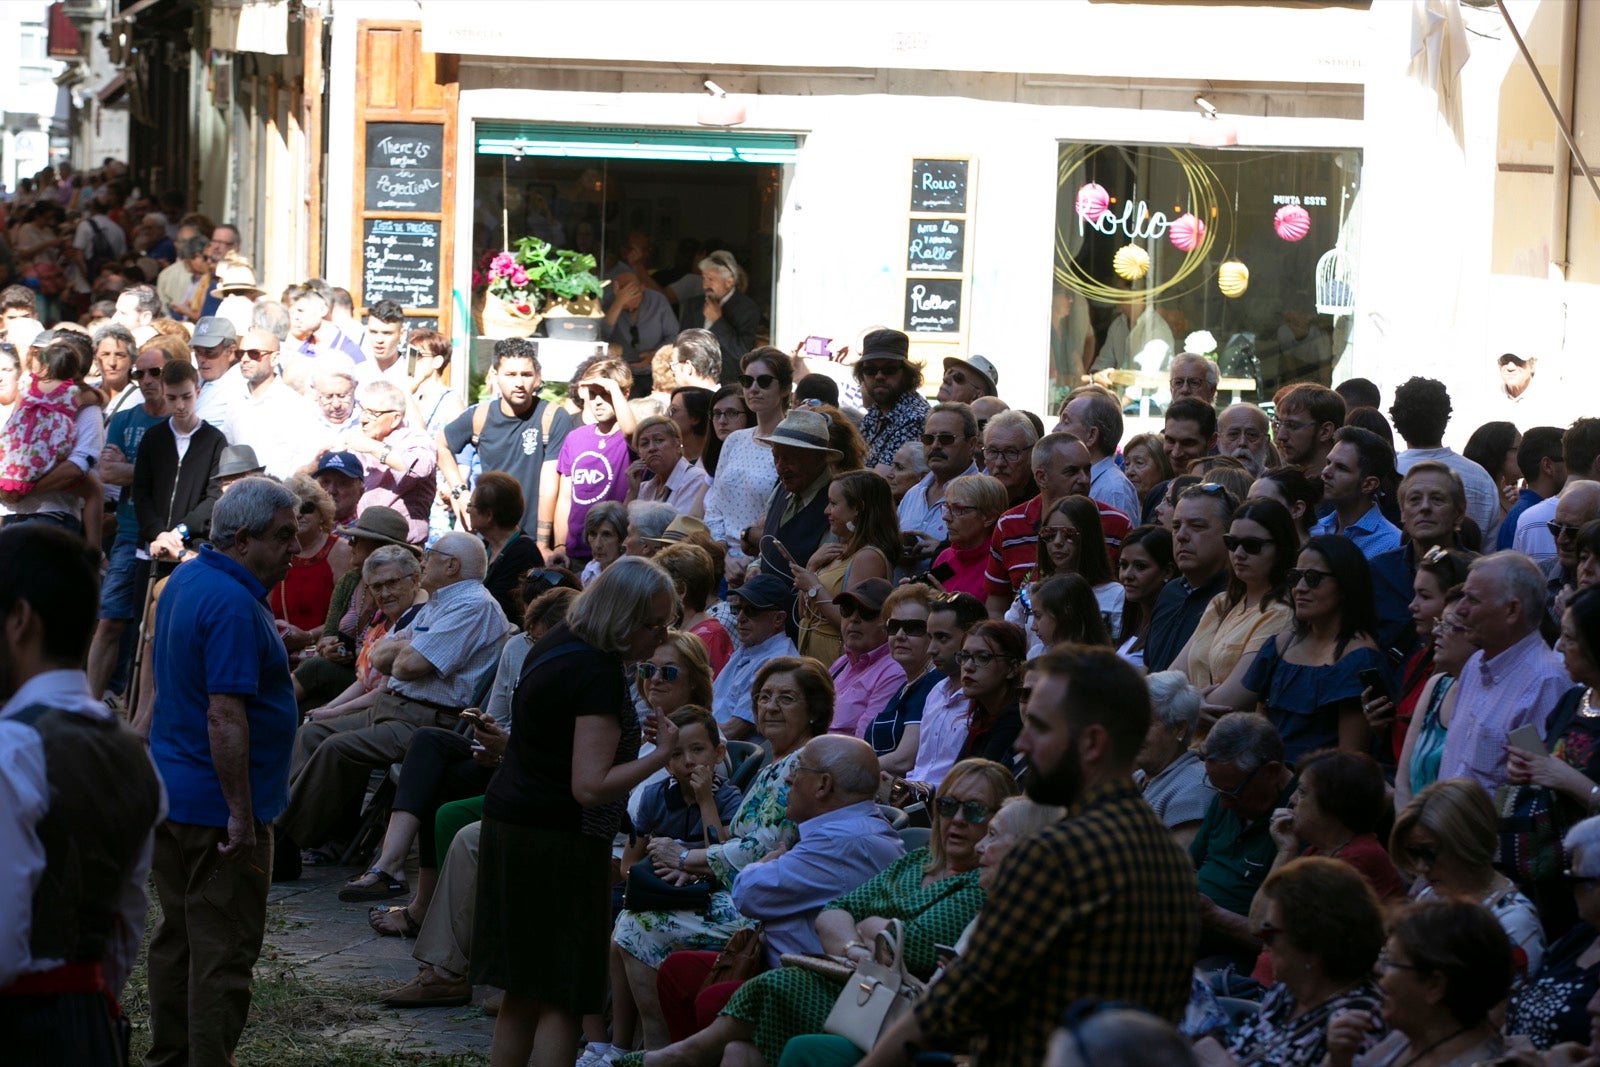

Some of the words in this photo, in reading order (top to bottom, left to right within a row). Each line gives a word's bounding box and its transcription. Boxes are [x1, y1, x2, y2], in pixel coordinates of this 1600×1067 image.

[1077, 189, 1174, 240] Rollo
[910, 239, 957, 261] Rollo
[910, 284, 957, 314] Rollo
[573, 468, 606, 485] END
